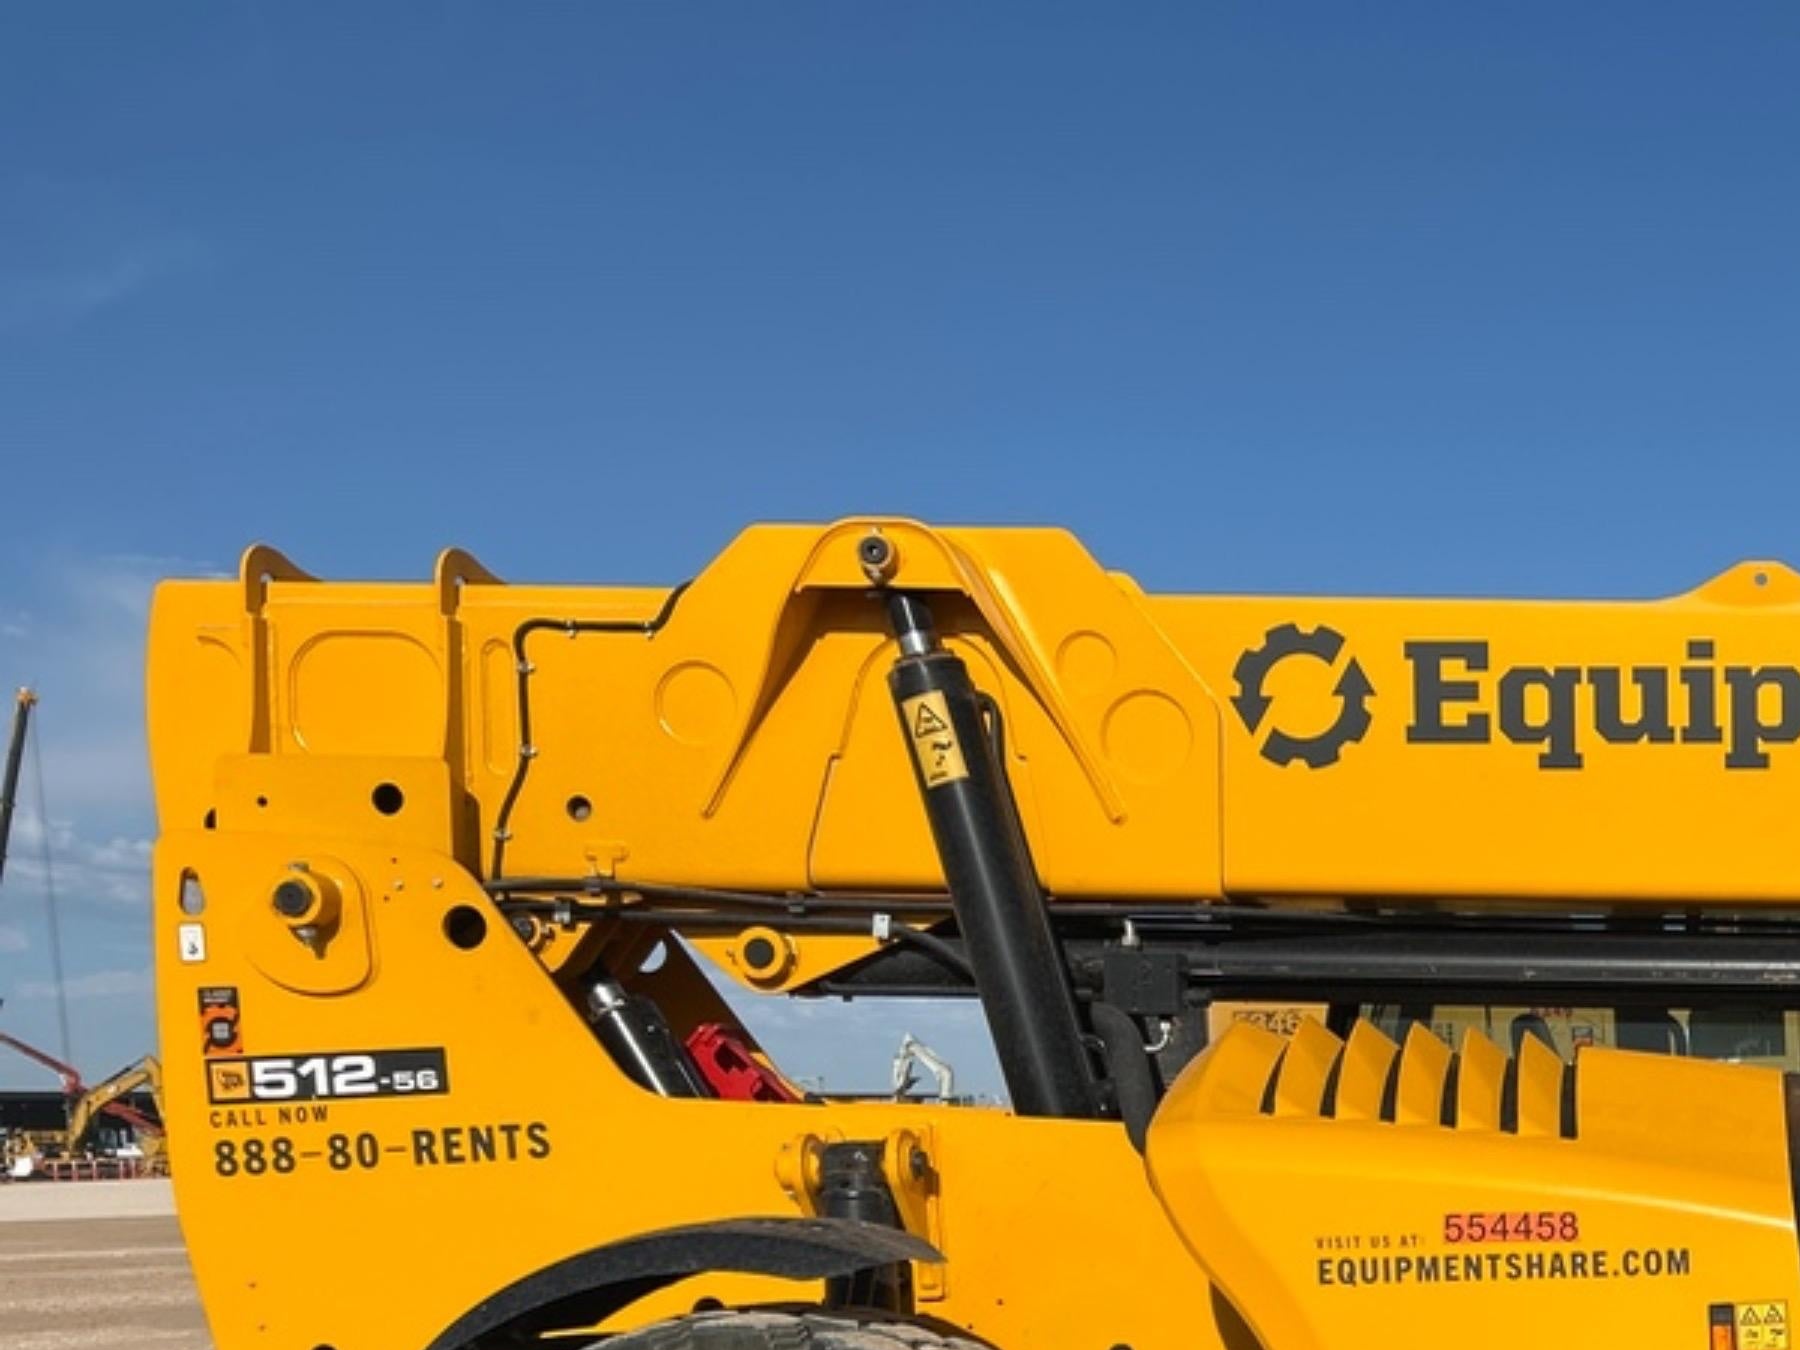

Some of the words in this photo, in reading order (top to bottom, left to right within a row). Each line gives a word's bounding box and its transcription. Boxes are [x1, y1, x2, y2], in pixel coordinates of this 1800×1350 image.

[209, 1107, 267, 1128] CALL
[278, 1105, 329, 1125] NOW
[215, 1121, 552, 1177] 888-80-RENTS
[1316, 1235, 1361, 1250] VISIT
[1369, 1235, 1391, 1249] US
[1445, 1211, 1579, 1243] 554458
[1318, 1248, 1691, 1287] EQUIPMENTSHARE.COM
